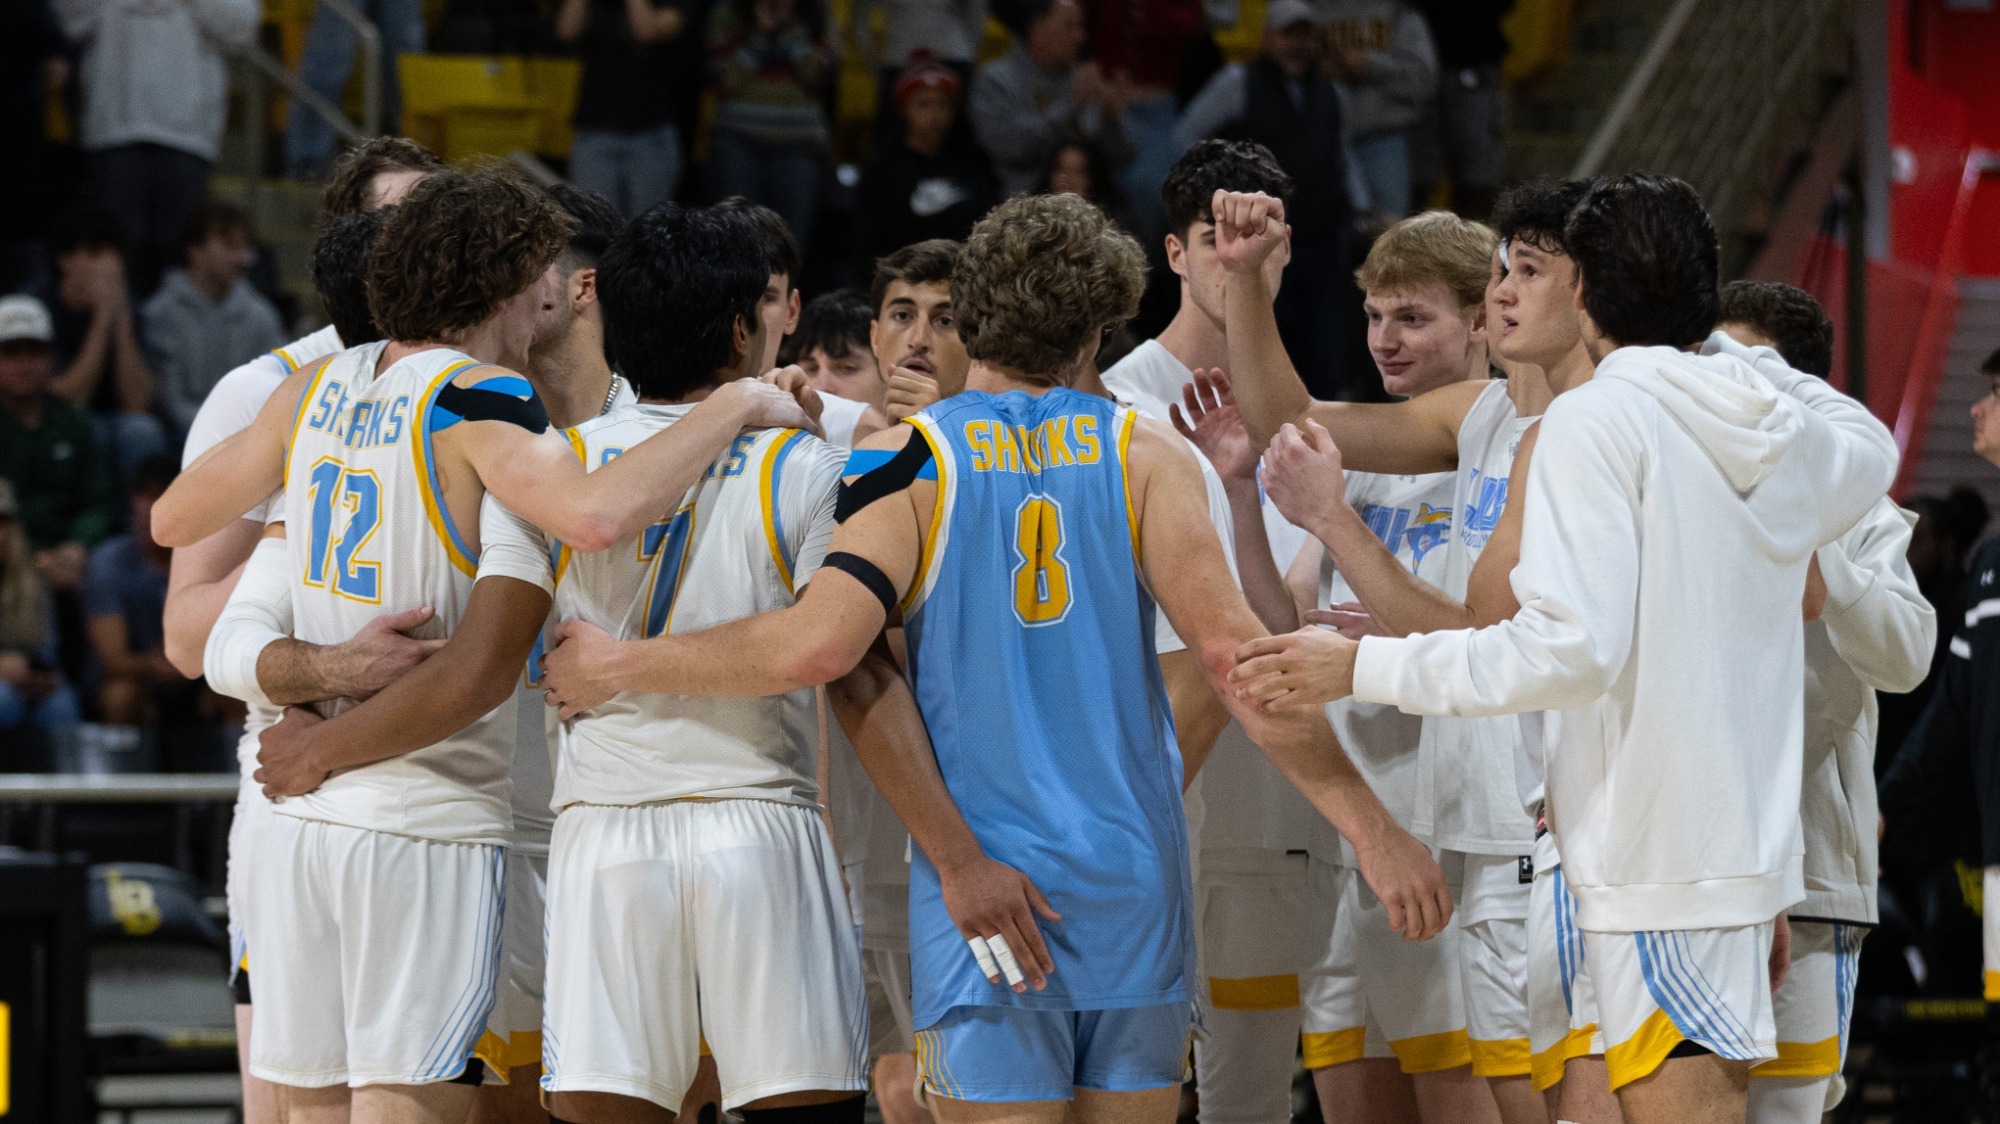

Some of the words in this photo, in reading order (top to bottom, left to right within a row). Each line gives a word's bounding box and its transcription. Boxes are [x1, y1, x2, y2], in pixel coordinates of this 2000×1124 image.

[303, 455, 382, 605] 12
[636, 502, 696, 638] 7
[1011, 492, 1074, 629] 8
